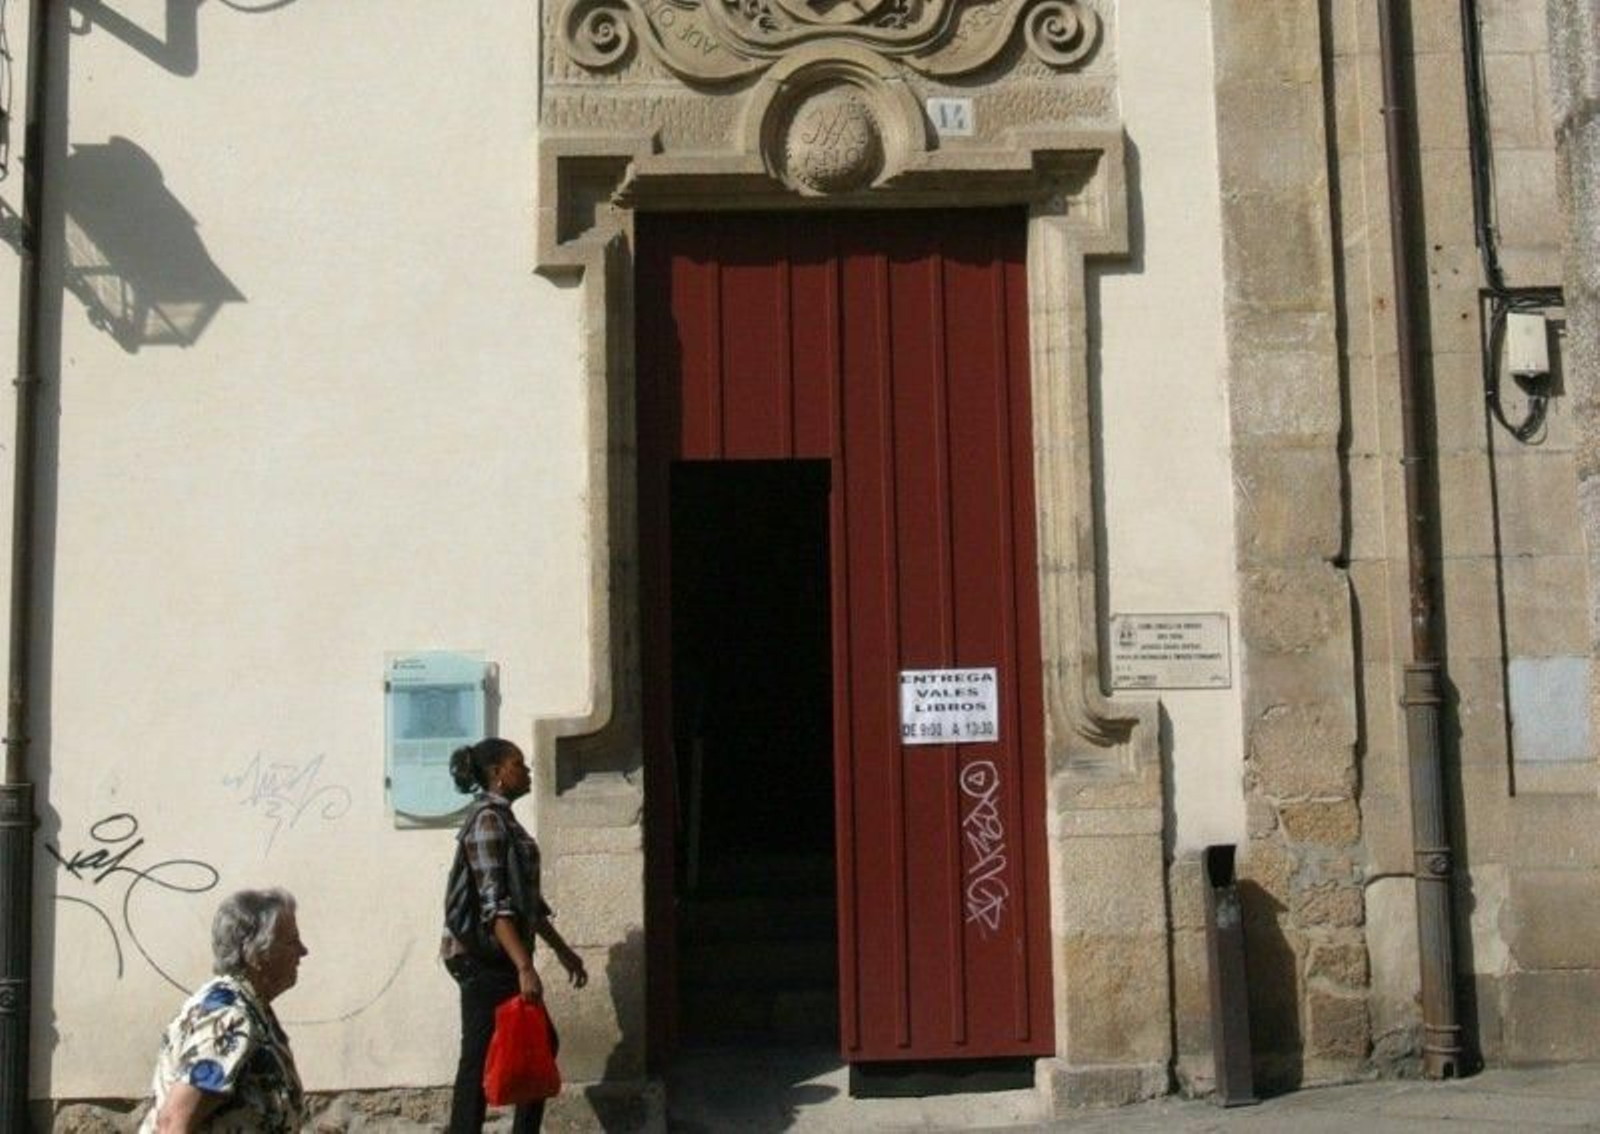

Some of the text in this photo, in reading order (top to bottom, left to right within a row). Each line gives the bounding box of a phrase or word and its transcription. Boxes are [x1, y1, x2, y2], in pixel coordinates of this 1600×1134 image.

[939, 103, 965, 130] 14
[900, 673, 993, 684] ENTREGA
[916, 688, 979, 699] VALES
[915, 702, 987, 713] LIBROS
[902, 723, 916, 737] DE
[952, 722, 960, 735] A
